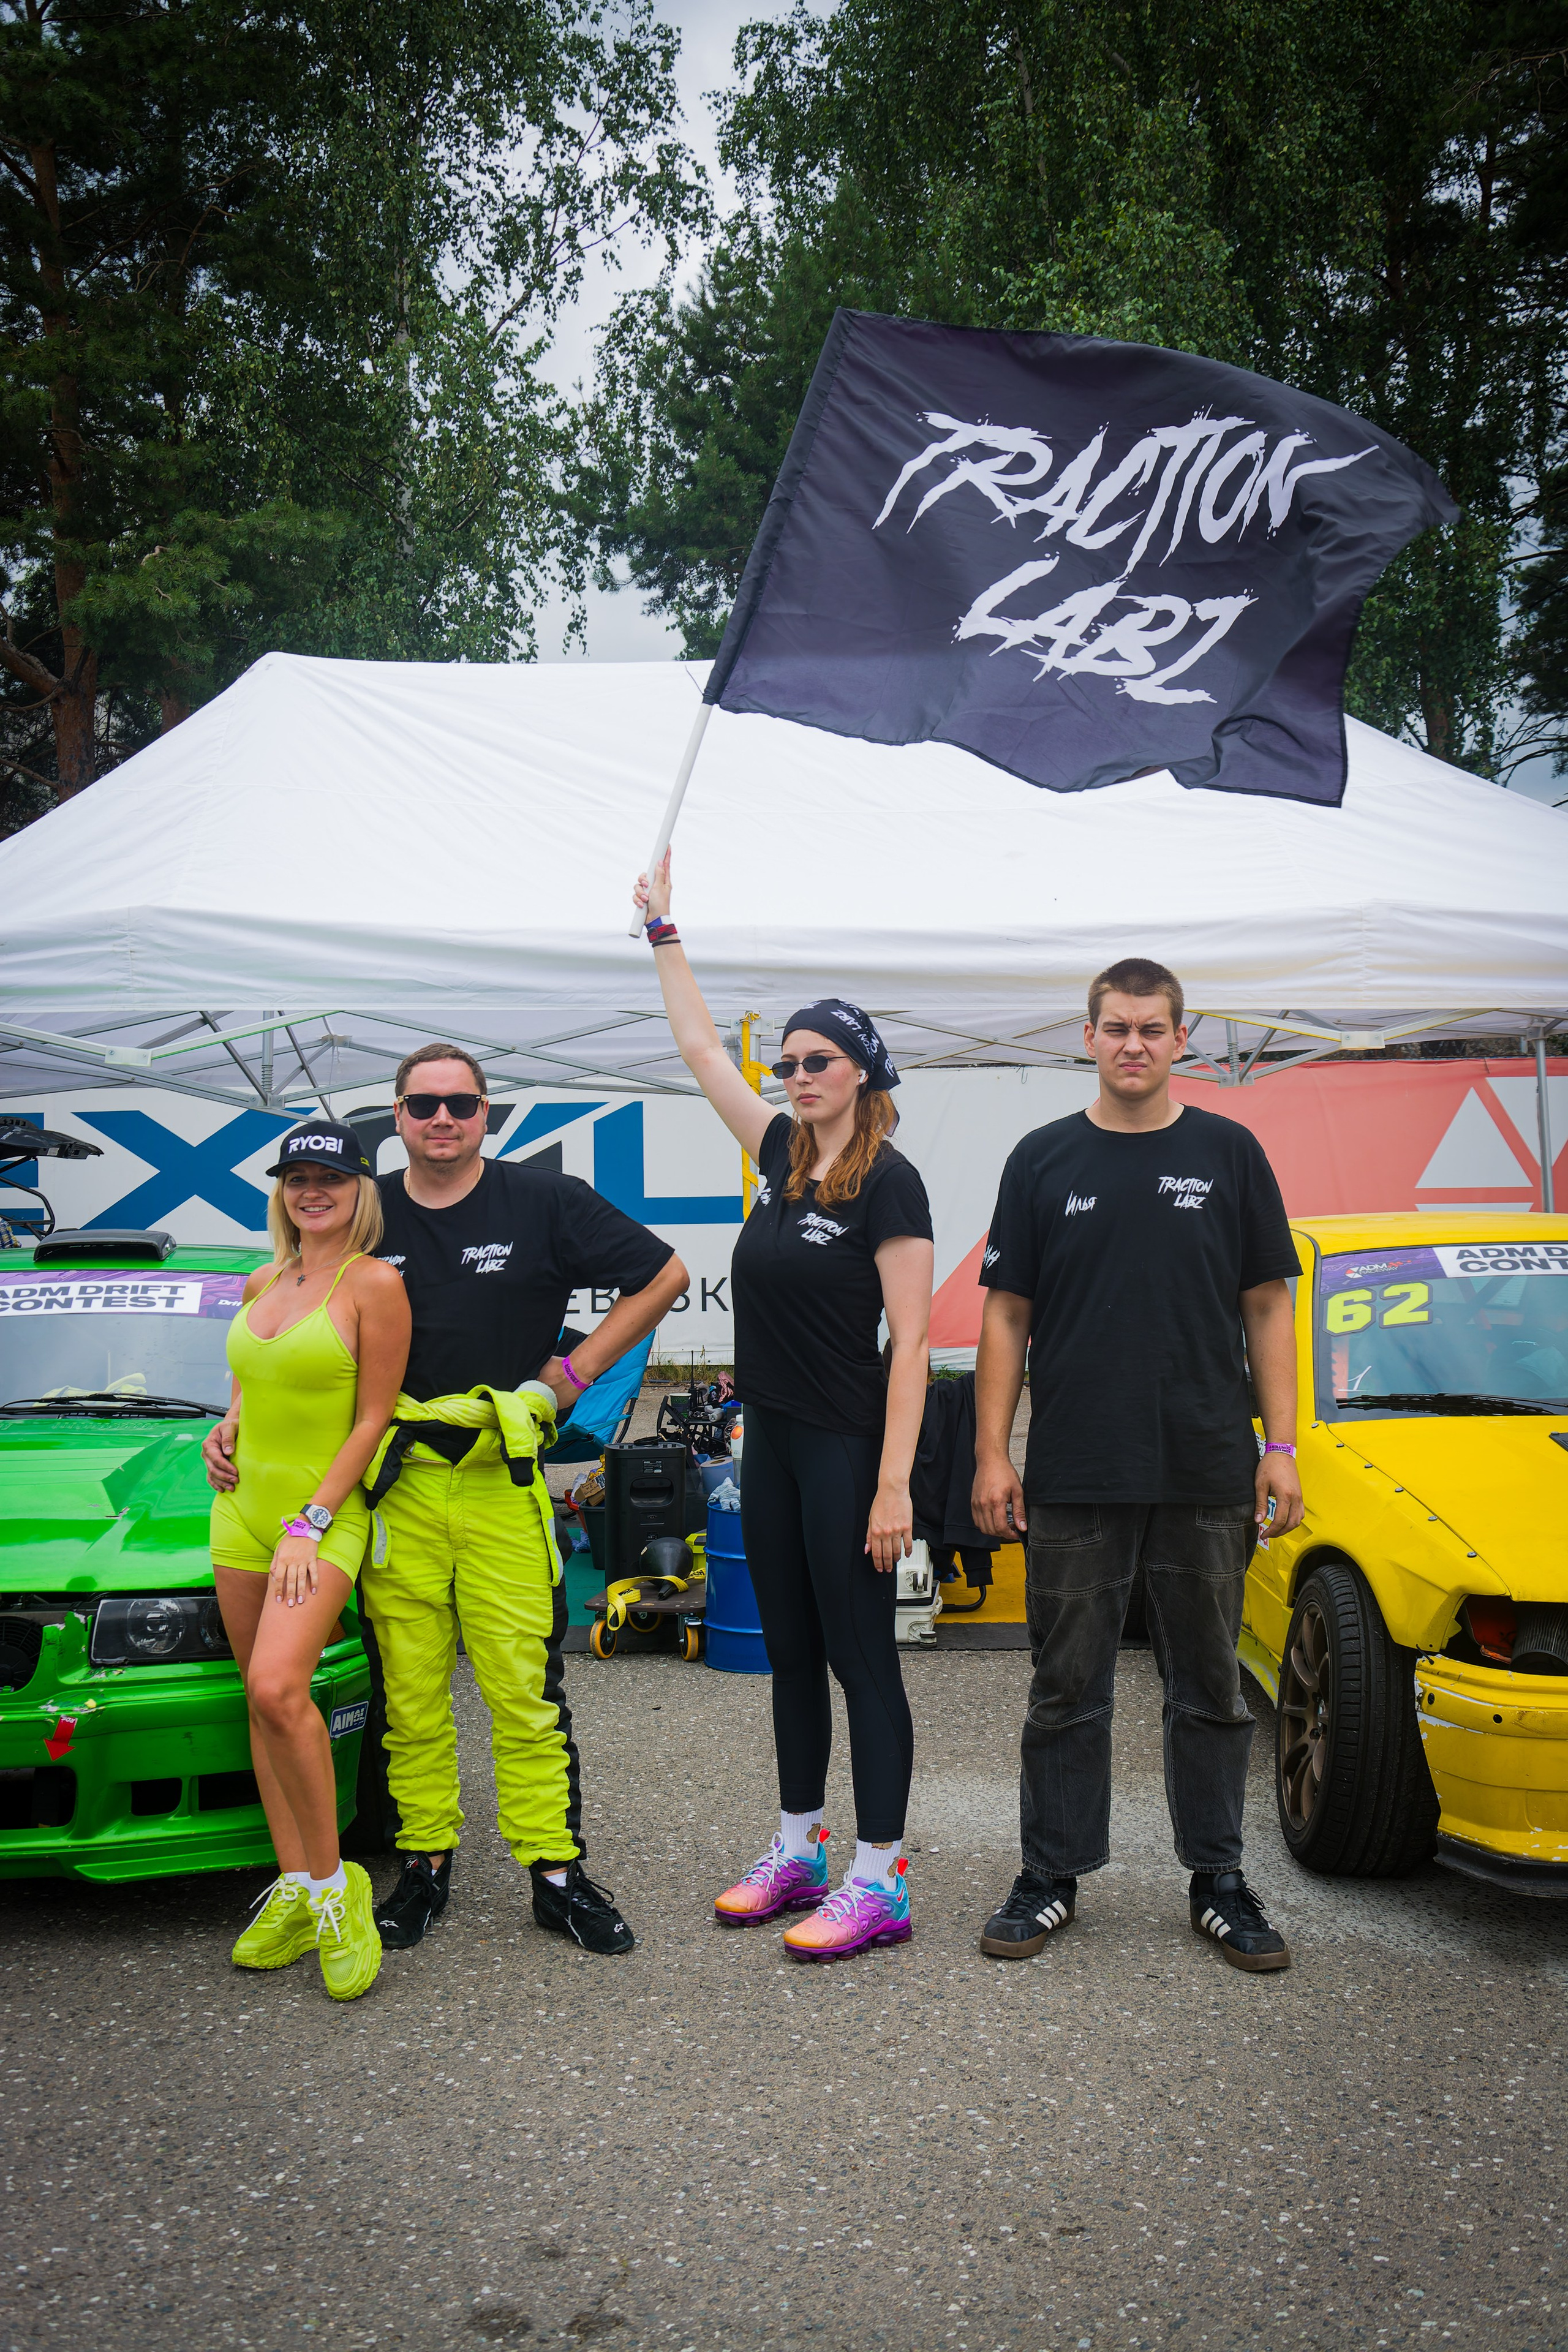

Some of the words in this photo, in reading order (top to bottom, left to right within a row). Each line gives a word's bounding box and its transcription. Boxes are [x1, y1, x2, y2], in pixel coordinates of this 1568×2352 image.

[872, 404, 1379, 581] TRACTION
[951, 551, 1259, 705] LABZ
[288, 1135, 344, 1155] RYOBI
[1158, 1175, 1214, 1194] TRACTION
[1173, 1193, 1207, 1210] LABZ
[797, 1212, 850, 1237] TRACTION
[801, 1227, 834, 1246] LABZ
[461, 1241, 513, 1265] TRACTION
[1456, 1247, 1539, 1260] ADM
[475, 1257, 507, 1274] LABZ
[1358, 1266, 1399, 1275] RACEWAY
[1359, 1262, 1387, 1272] ADM
[78, 1285, 186, 1296] DRIFT
[1326, 1282, 1429, 1334] 62
